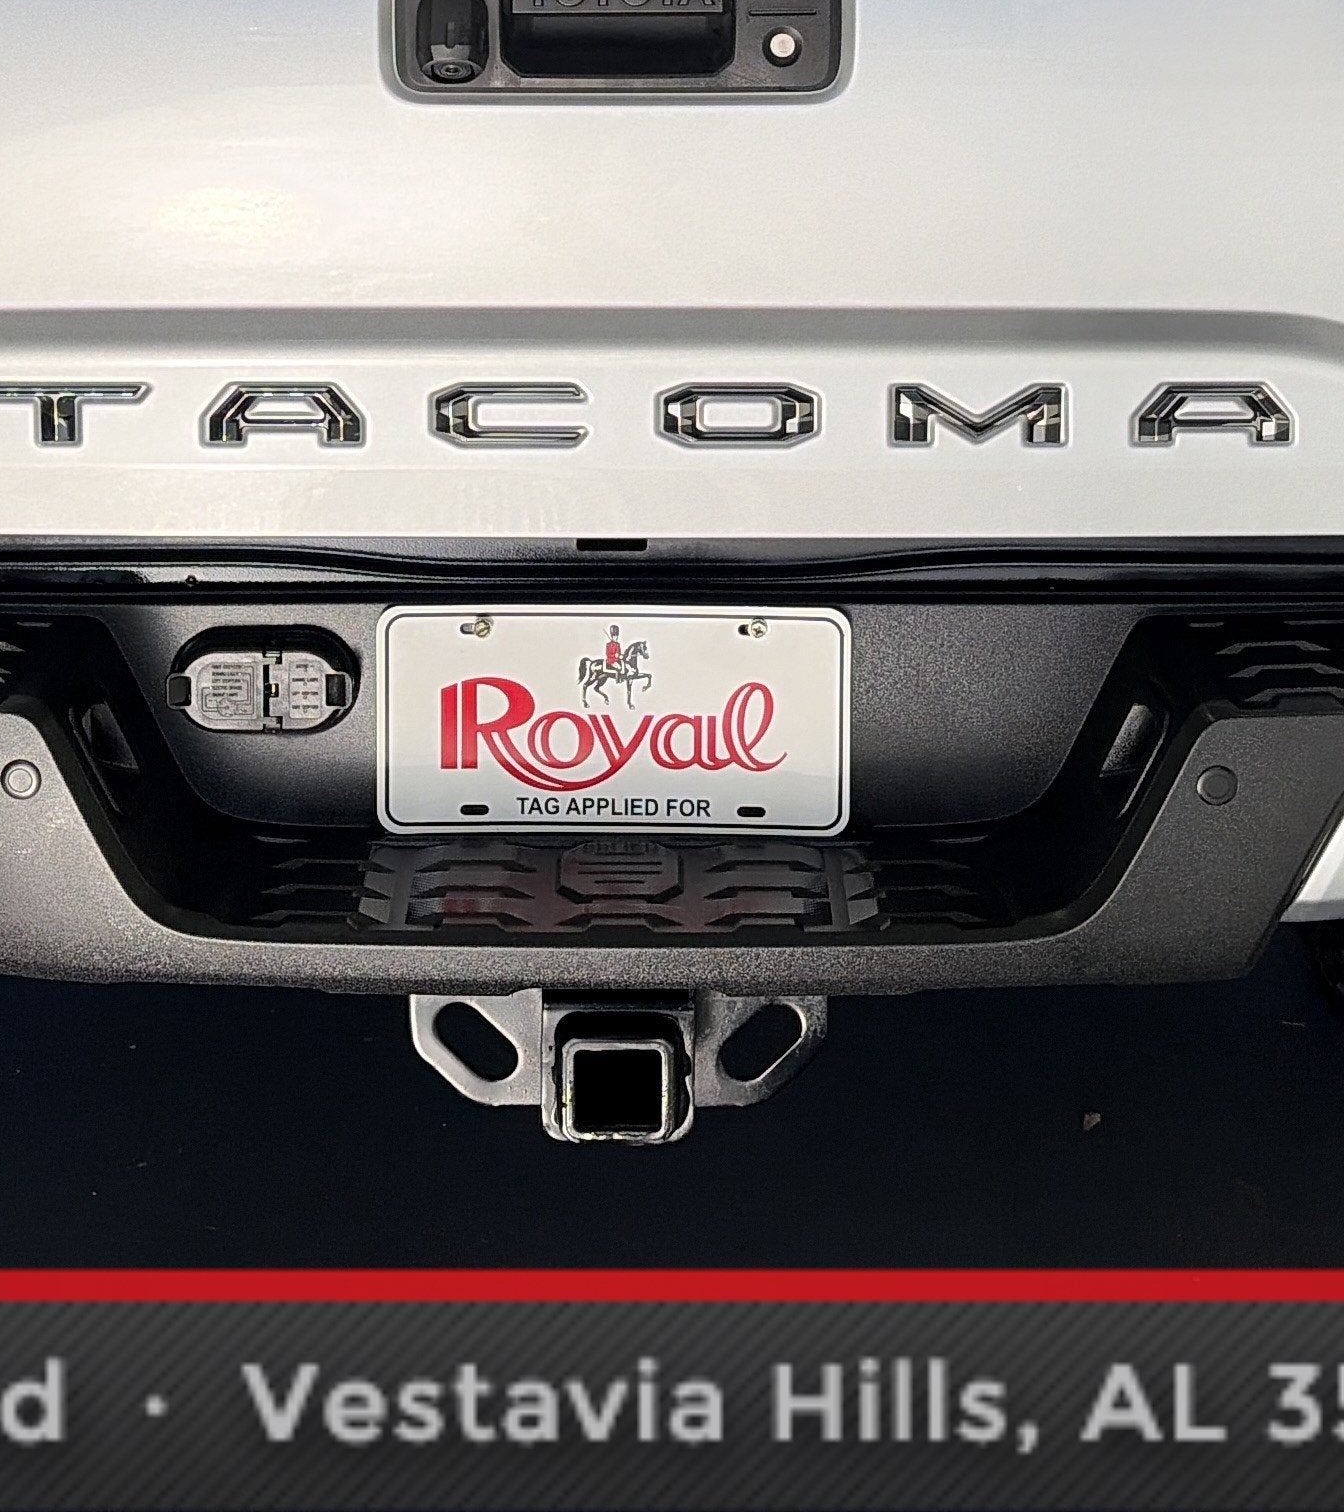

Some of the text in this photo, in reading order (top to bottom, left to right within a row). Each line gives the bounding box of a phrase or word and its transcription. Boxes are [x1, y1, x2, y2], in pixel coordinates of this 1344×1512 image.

[439, 676, 788, 792] Royal
[516, 796, 712, 818] TAG APPLIED FOR
